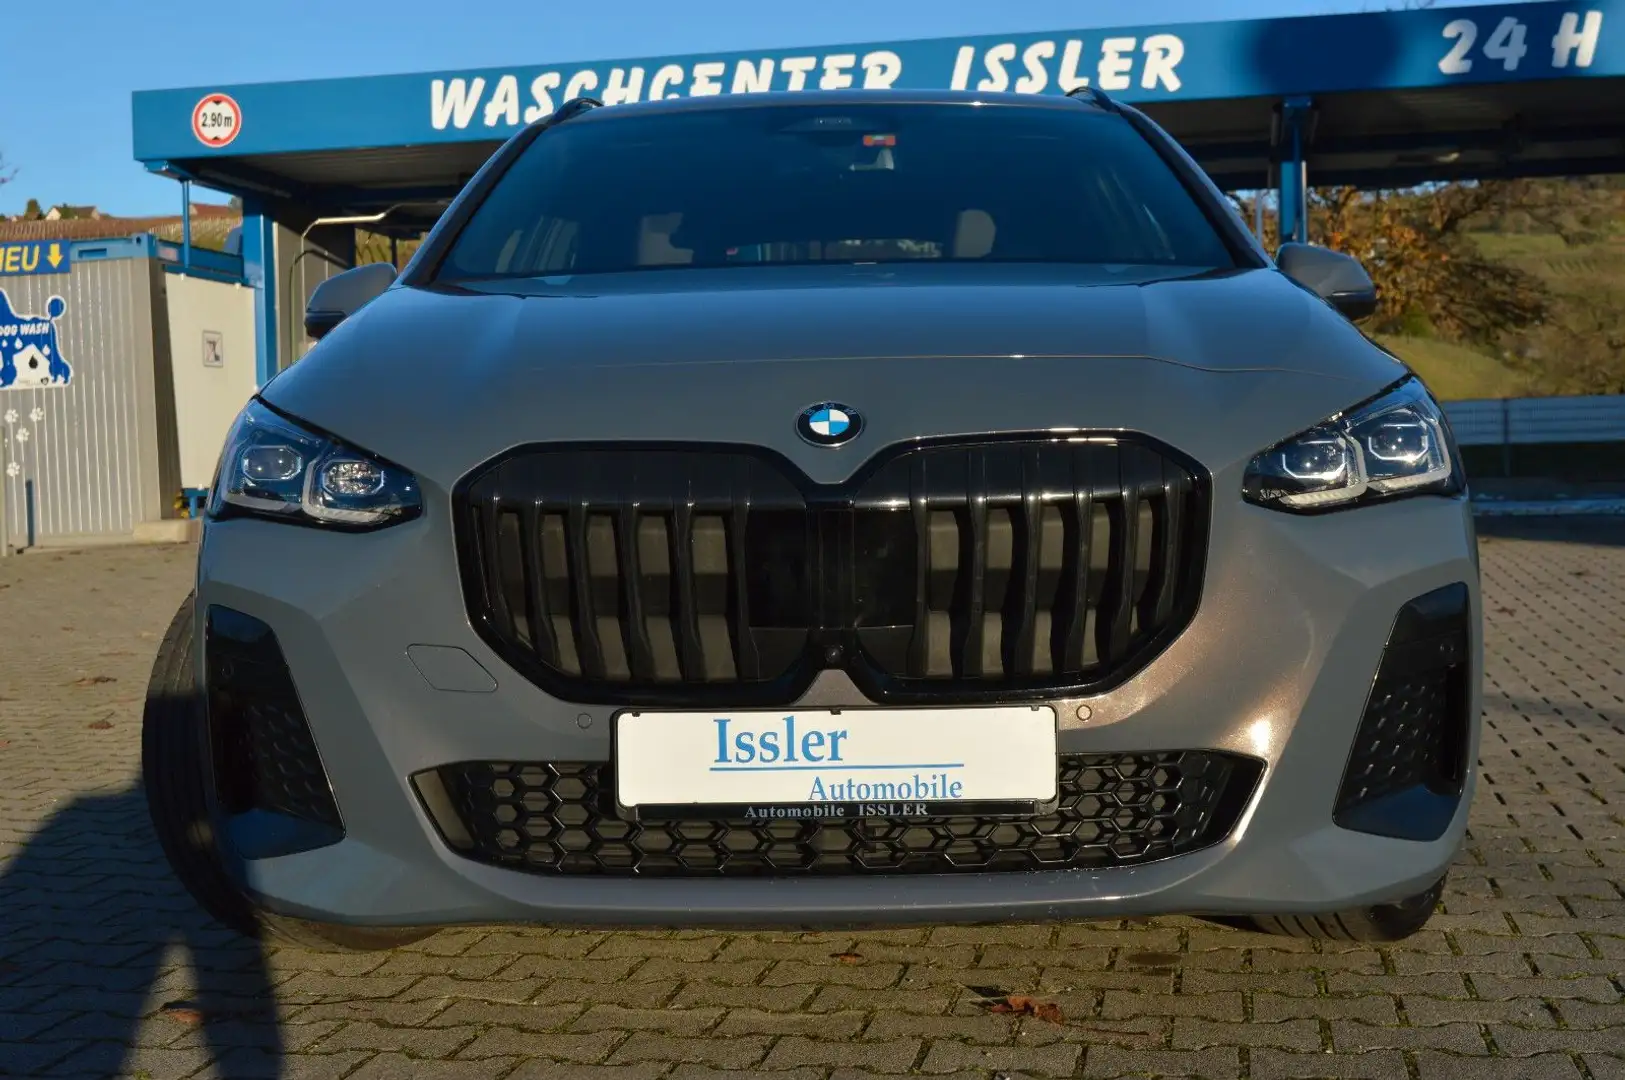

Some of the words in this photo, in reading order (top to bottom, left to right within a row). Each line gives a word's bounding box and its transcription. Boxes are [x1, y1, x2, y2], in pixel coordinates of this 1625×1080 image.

[1438, 16, 1527, 75] 24
[1551, 10, 1603, 68] H
[431, 51, 902, 130] WASCHCENTER
[950, 34, 1185, 94] ISSLER
[20, 322, 50, 336] WASH
[713, 716, 848, 764] Issler
[808, 773, 963, 801] Automobile
[744, 804, 845, 818] Automobile
[858, 802, 929, 816] ISSLER
